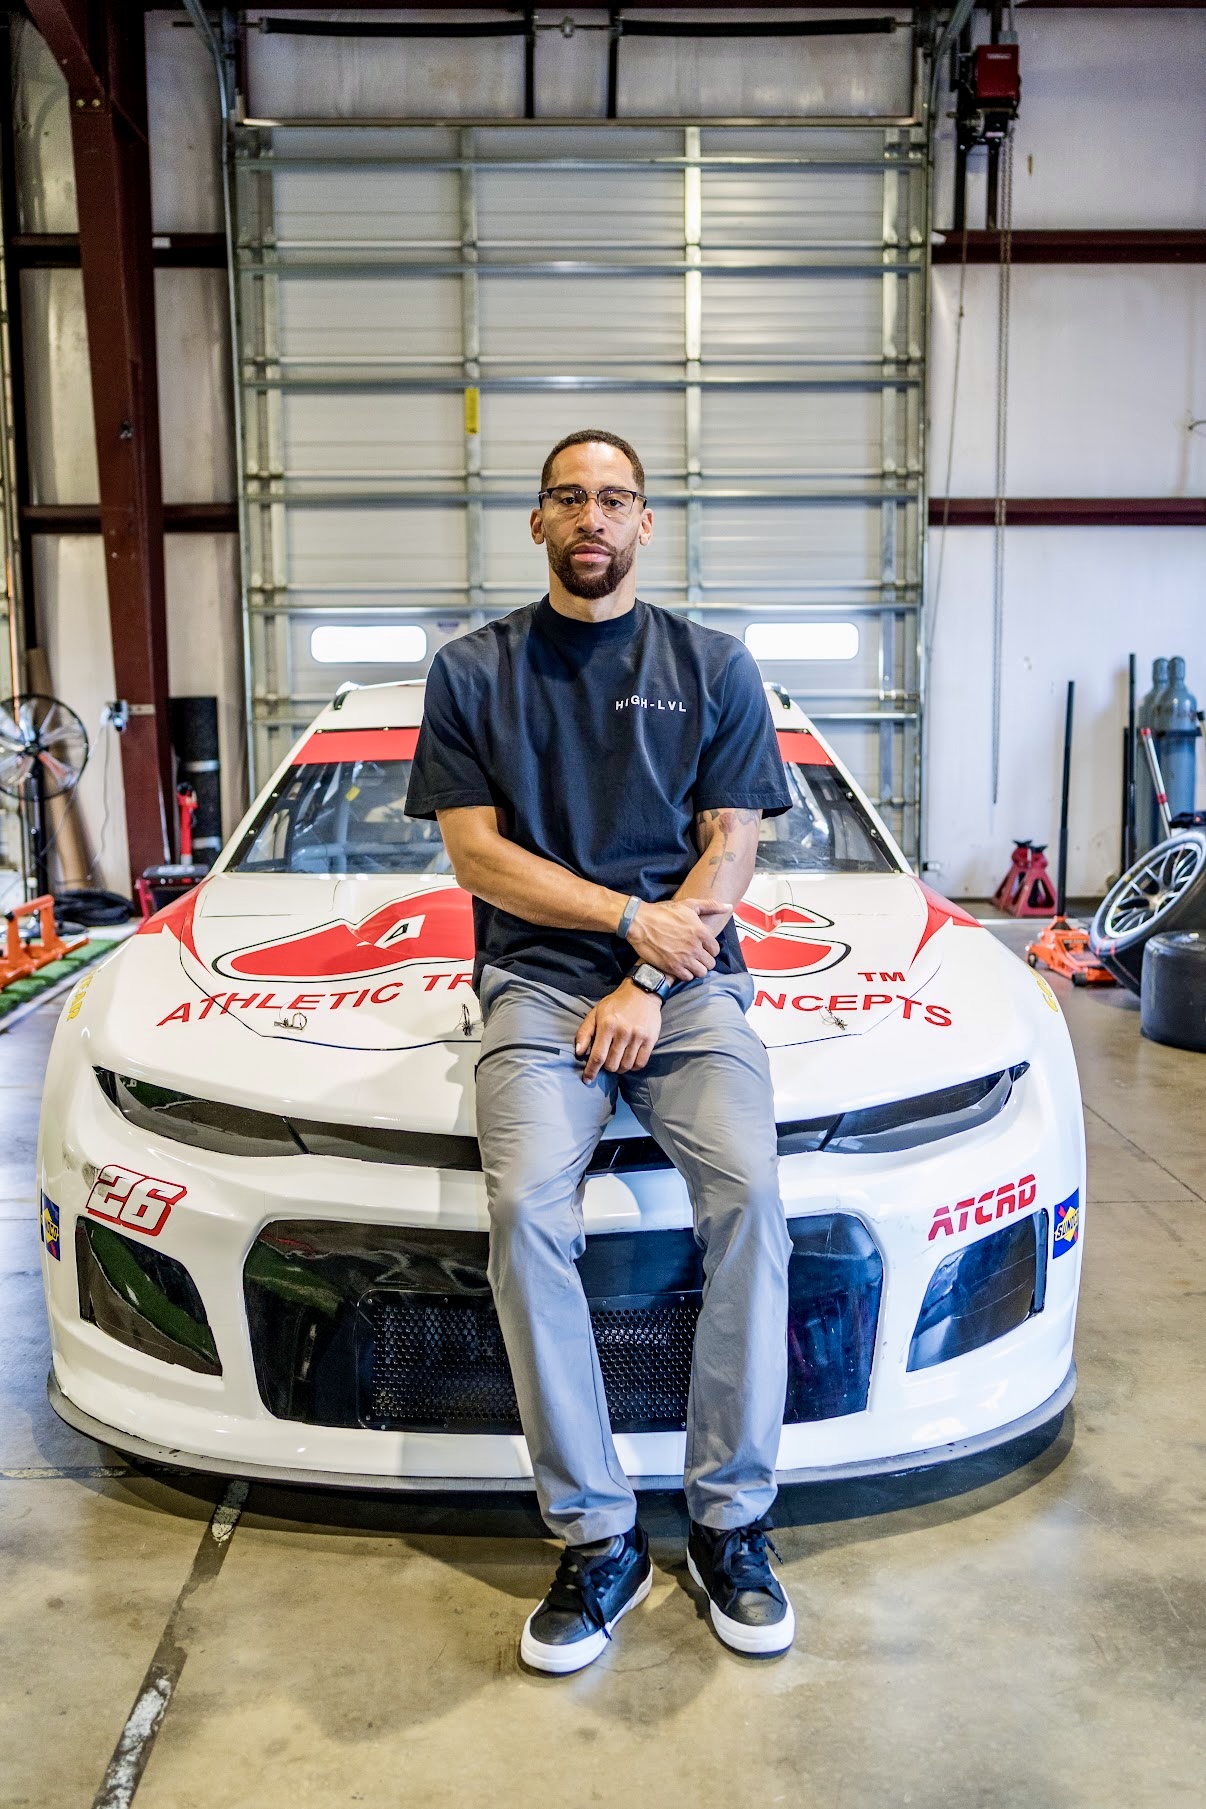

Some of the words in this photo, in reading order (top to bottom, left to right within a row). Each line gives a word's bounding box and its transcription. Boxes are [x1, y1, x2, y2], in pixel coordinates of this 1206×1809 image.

[615, 694, 687, 713] HIGH-LVL
[857, 971, 906, 982] TM
[156, 982, 404, 1027] ATHLETIC
[754, 990, 953, 1027] NCEPTS
[85, 1164, 188, 1237] 26
